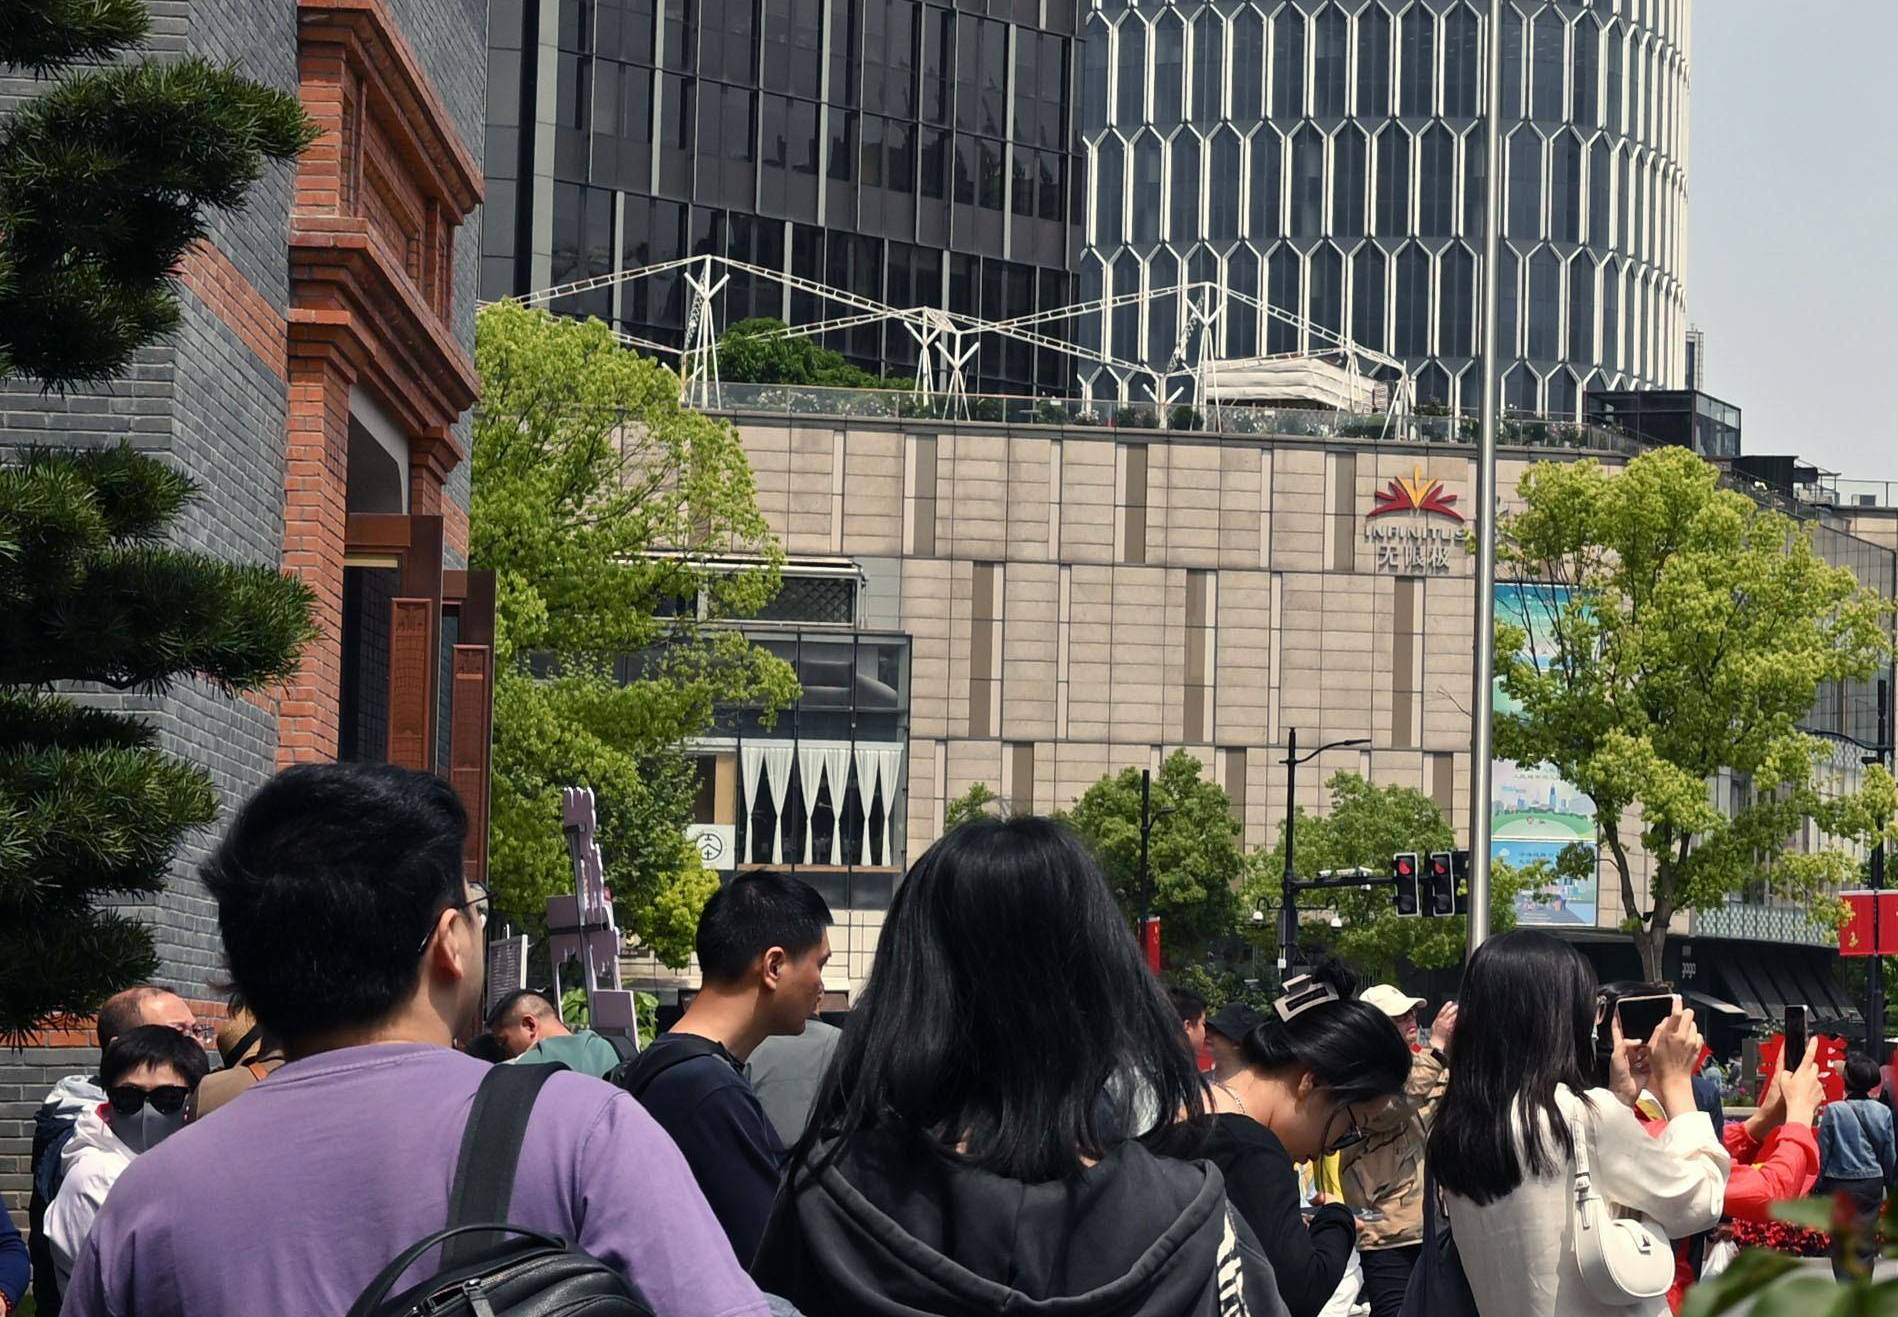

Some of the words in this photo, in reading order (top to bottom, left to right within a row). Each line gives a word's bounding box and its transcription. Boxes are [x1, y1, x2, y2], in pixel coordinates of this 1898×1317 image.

[1366, 525, 1465, 541] INFINITUS
[1377, 545, 1449, 568] 无限极
